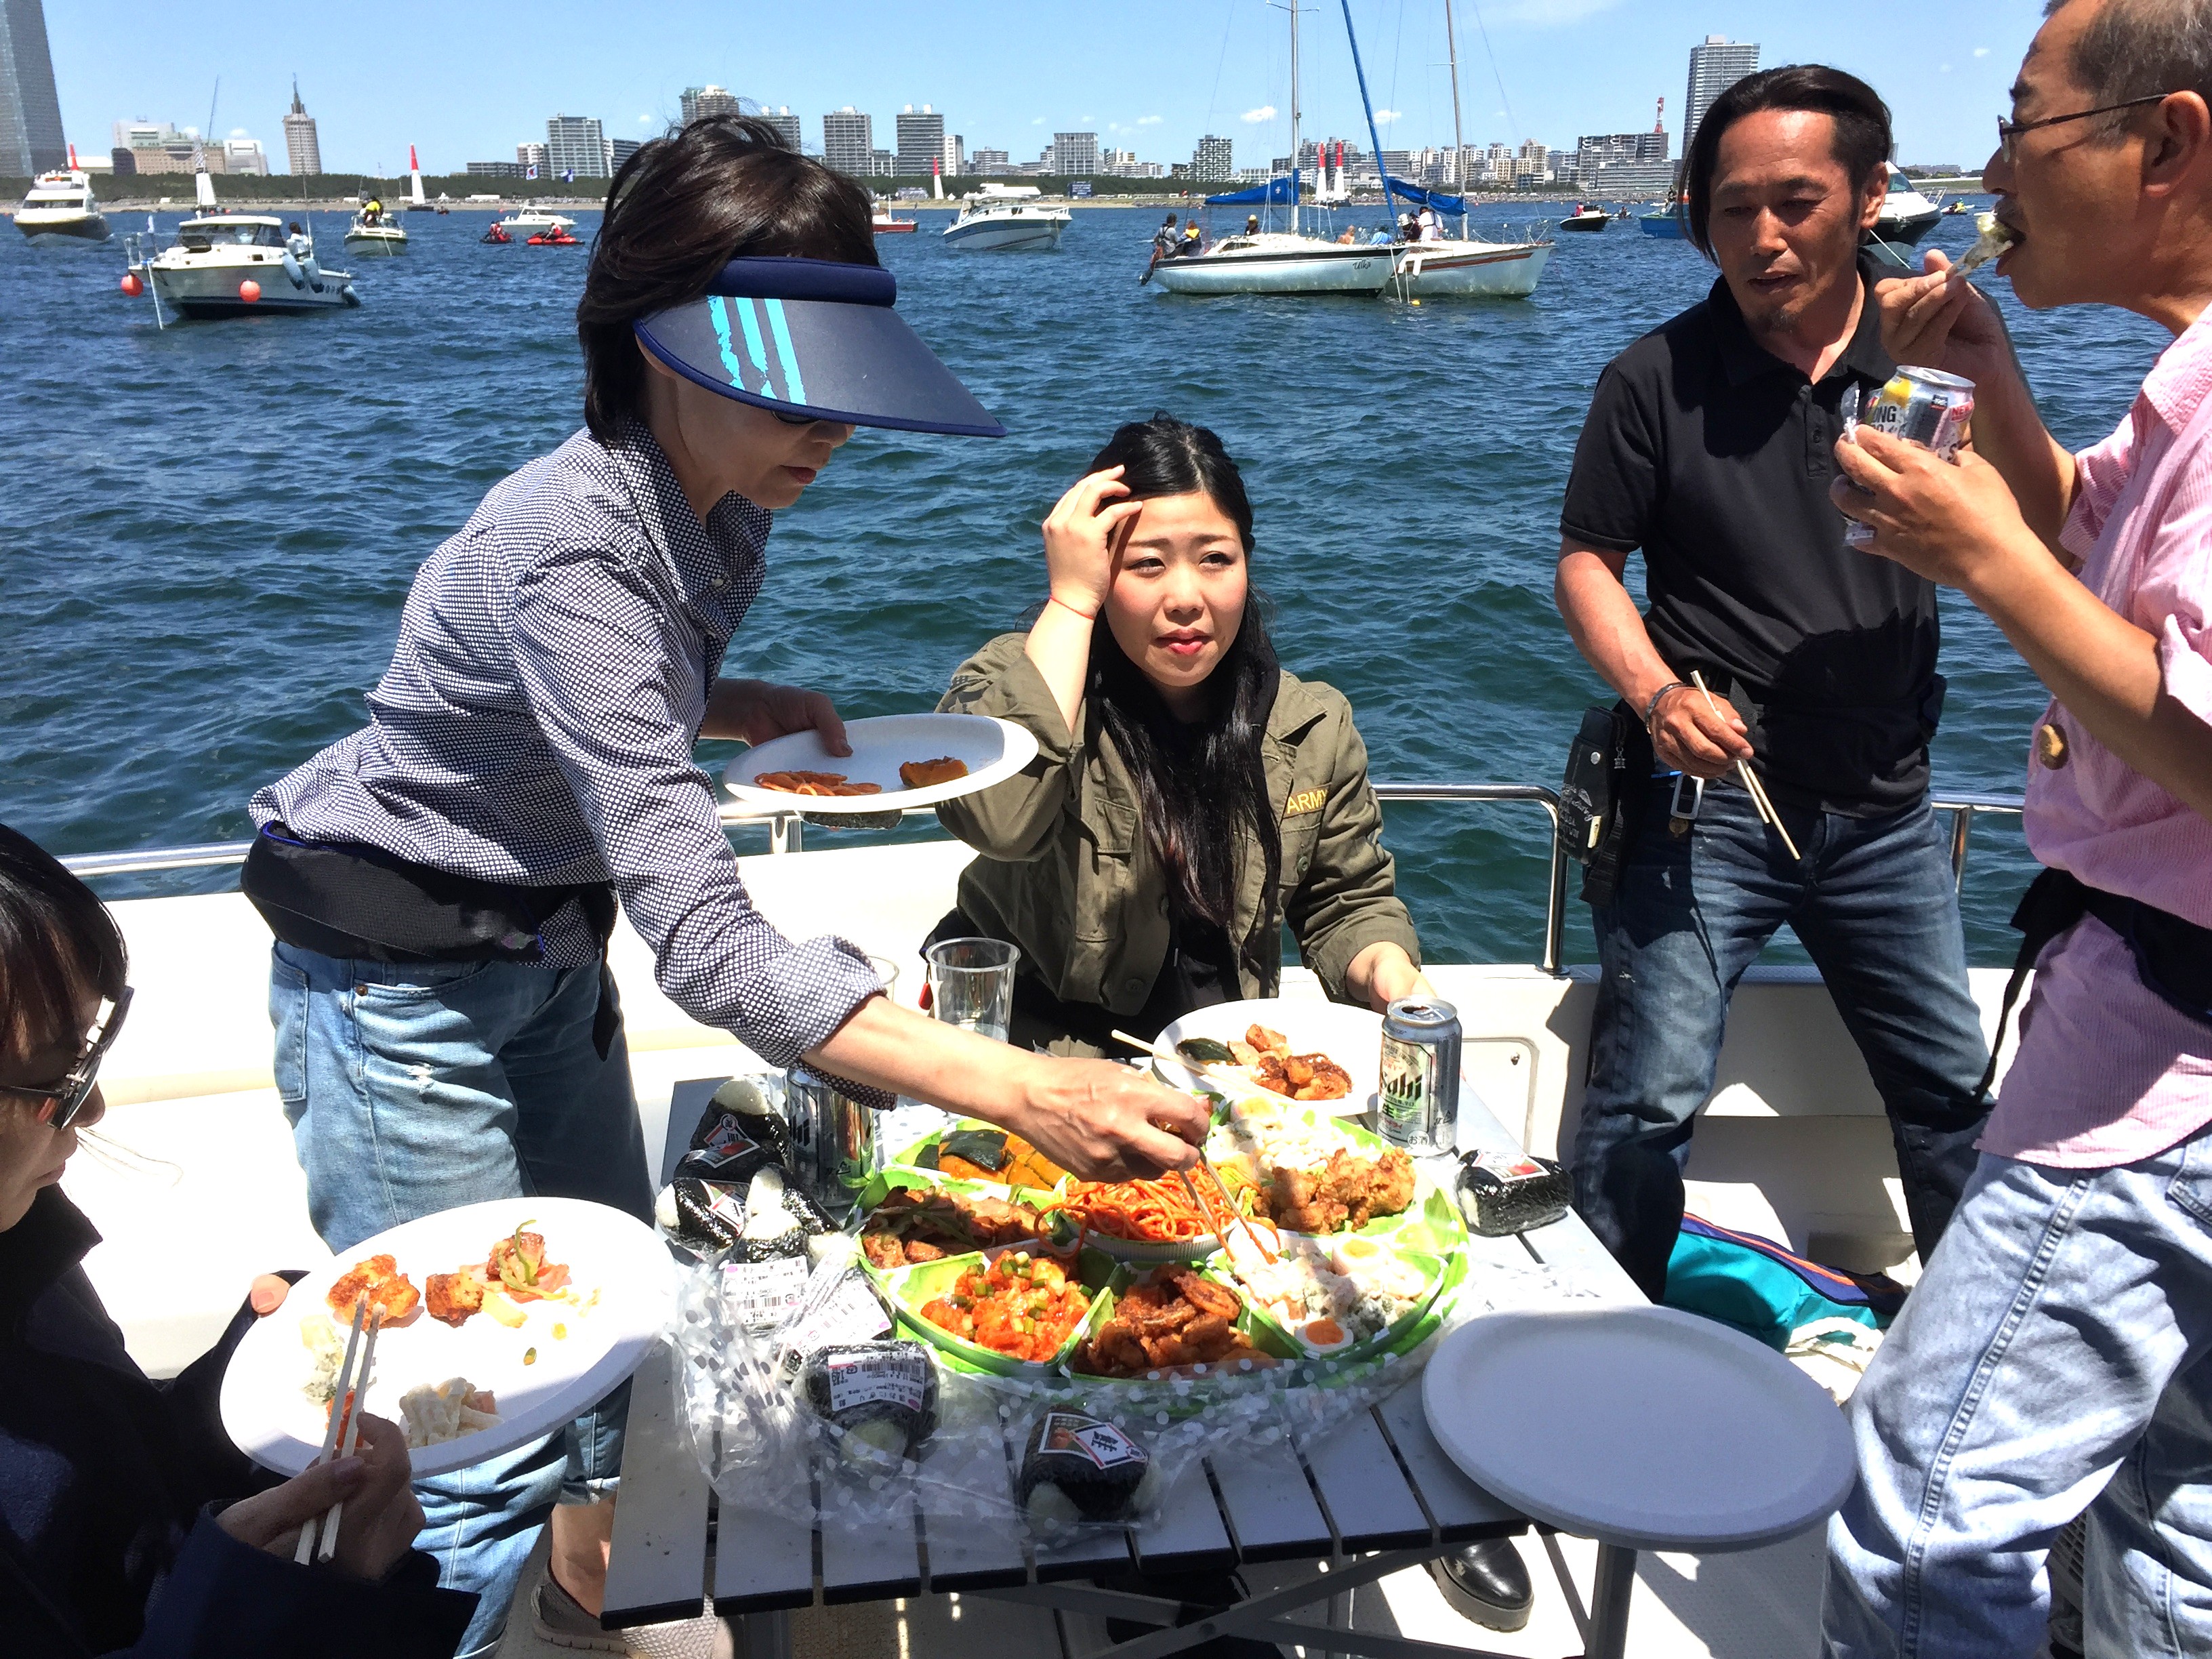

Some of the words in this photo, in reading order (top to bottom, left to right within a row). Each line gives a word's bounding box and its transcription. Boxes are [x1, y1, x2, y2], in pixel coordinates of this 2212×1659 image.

[1287, 789, 1328, 814] ARMY
[1382, 1103, 1394, 1118] 生
[1408, 1136, 1429, 1145] お酒
